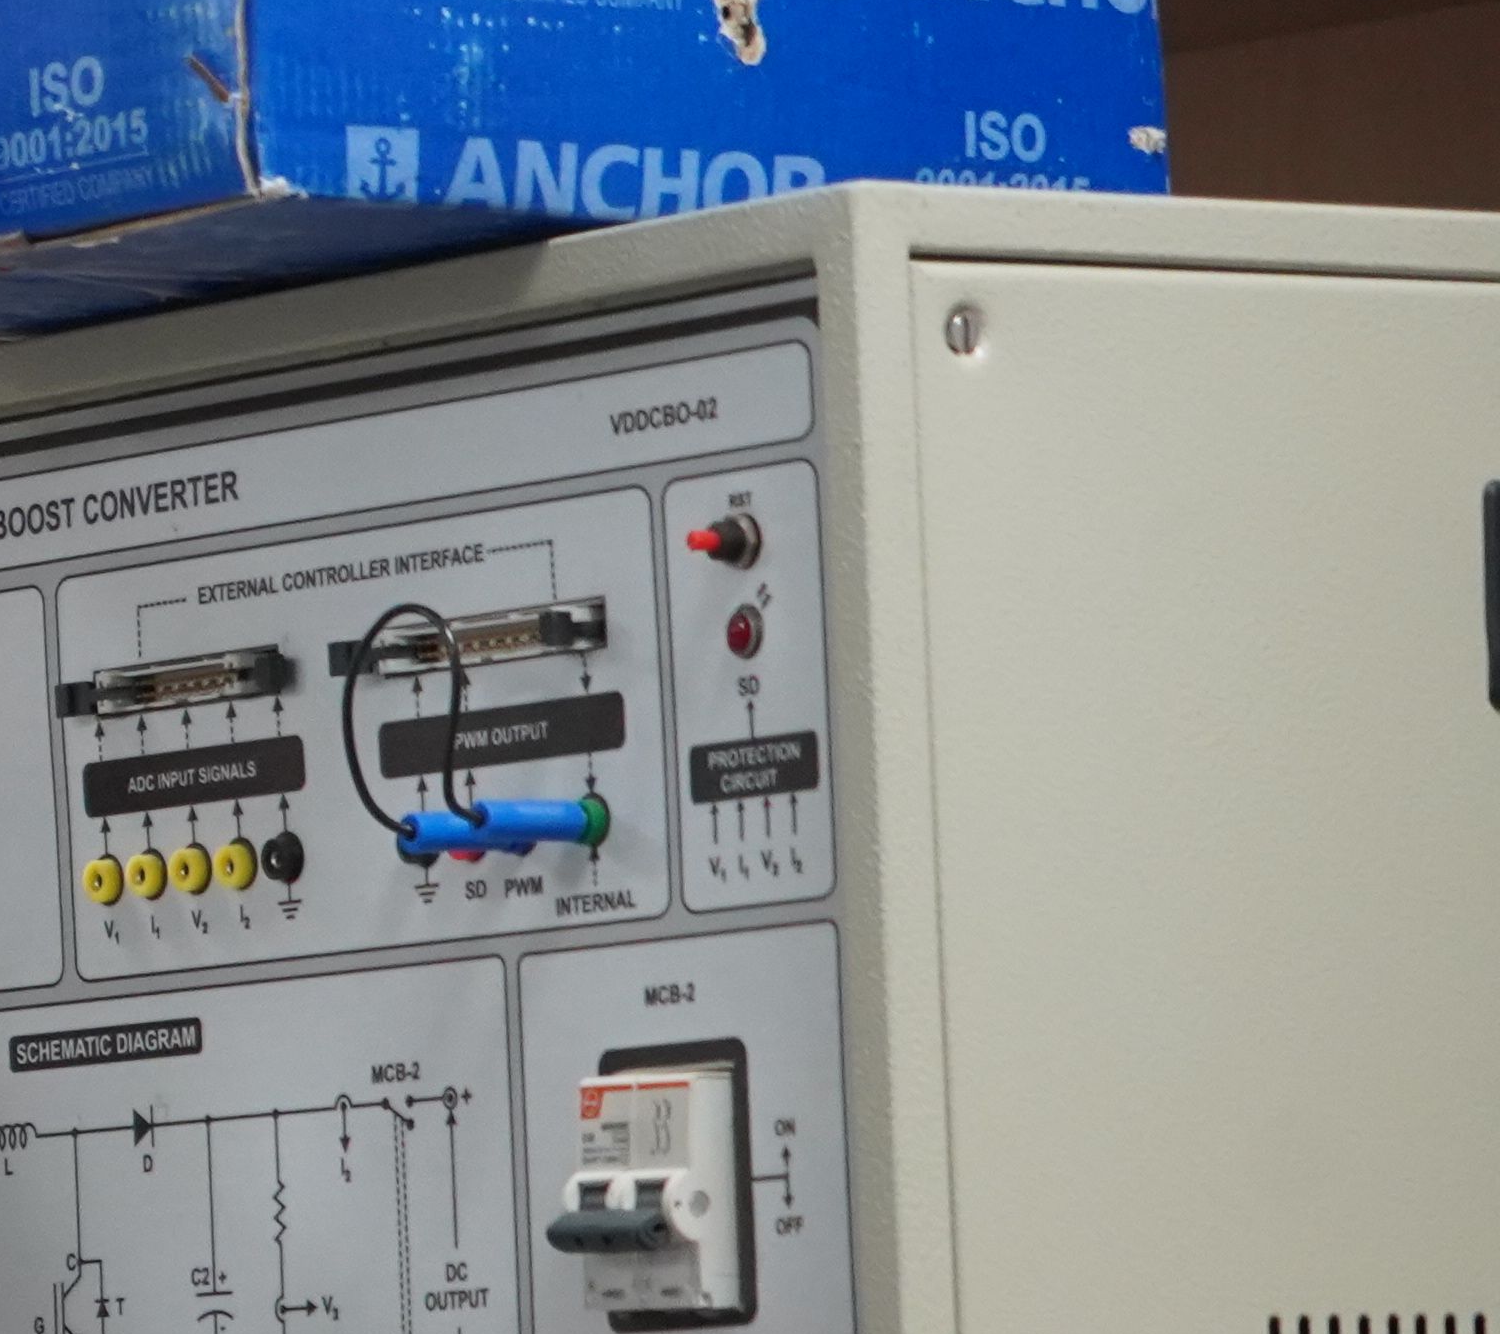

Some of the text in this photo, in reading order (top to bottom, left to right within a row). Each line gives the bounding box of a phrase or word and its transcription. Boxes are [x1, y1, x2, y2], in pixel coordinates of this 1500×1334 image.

[29, 55, 104, 118] ISO
[964, 110, 1047, 163] ISO
[610, 397, 718, 436] VDDCBO-02
[83, 470, 239, 525] CONVERTER
[197, 543, 484, 606] EXTERNAL CONTROLLER INTERFACE
[737, 674, 760, 696] SD
[453, 721, 548, 749] PWM OUTPUT
[707, 741, 801, 770] PROTECTION
[127, 760, 257, 794] ADC INPUT SIGNALS
[720, 768, 778, 794] CIRCUIT
[465, 875, 543, 899] SD PWM
[556, 889, 637, 915] INTERNAL
[644, 983, 695, 1007] MCB-2
[16, 1025, 197, 1065] SCHEMATIC DIAGRAM
[371, 1062, 420, 1083] MCB-2
[775, 1118, 795, 1136] ON
[4, 1158, 13, 1175] L
[143, 1154, 153, 1172] D
[776, 1216, 803, 1235] OFF
[66, 1253, 76, 1270] C
[446, 1263, 467, 1282] DC
[191, 1268, 209, 1286] C2
[116, 1298, 126, 1315] T
[425, 1288, 489, 1311] OUTPUT
[34, 1317, 45, 1334] G
